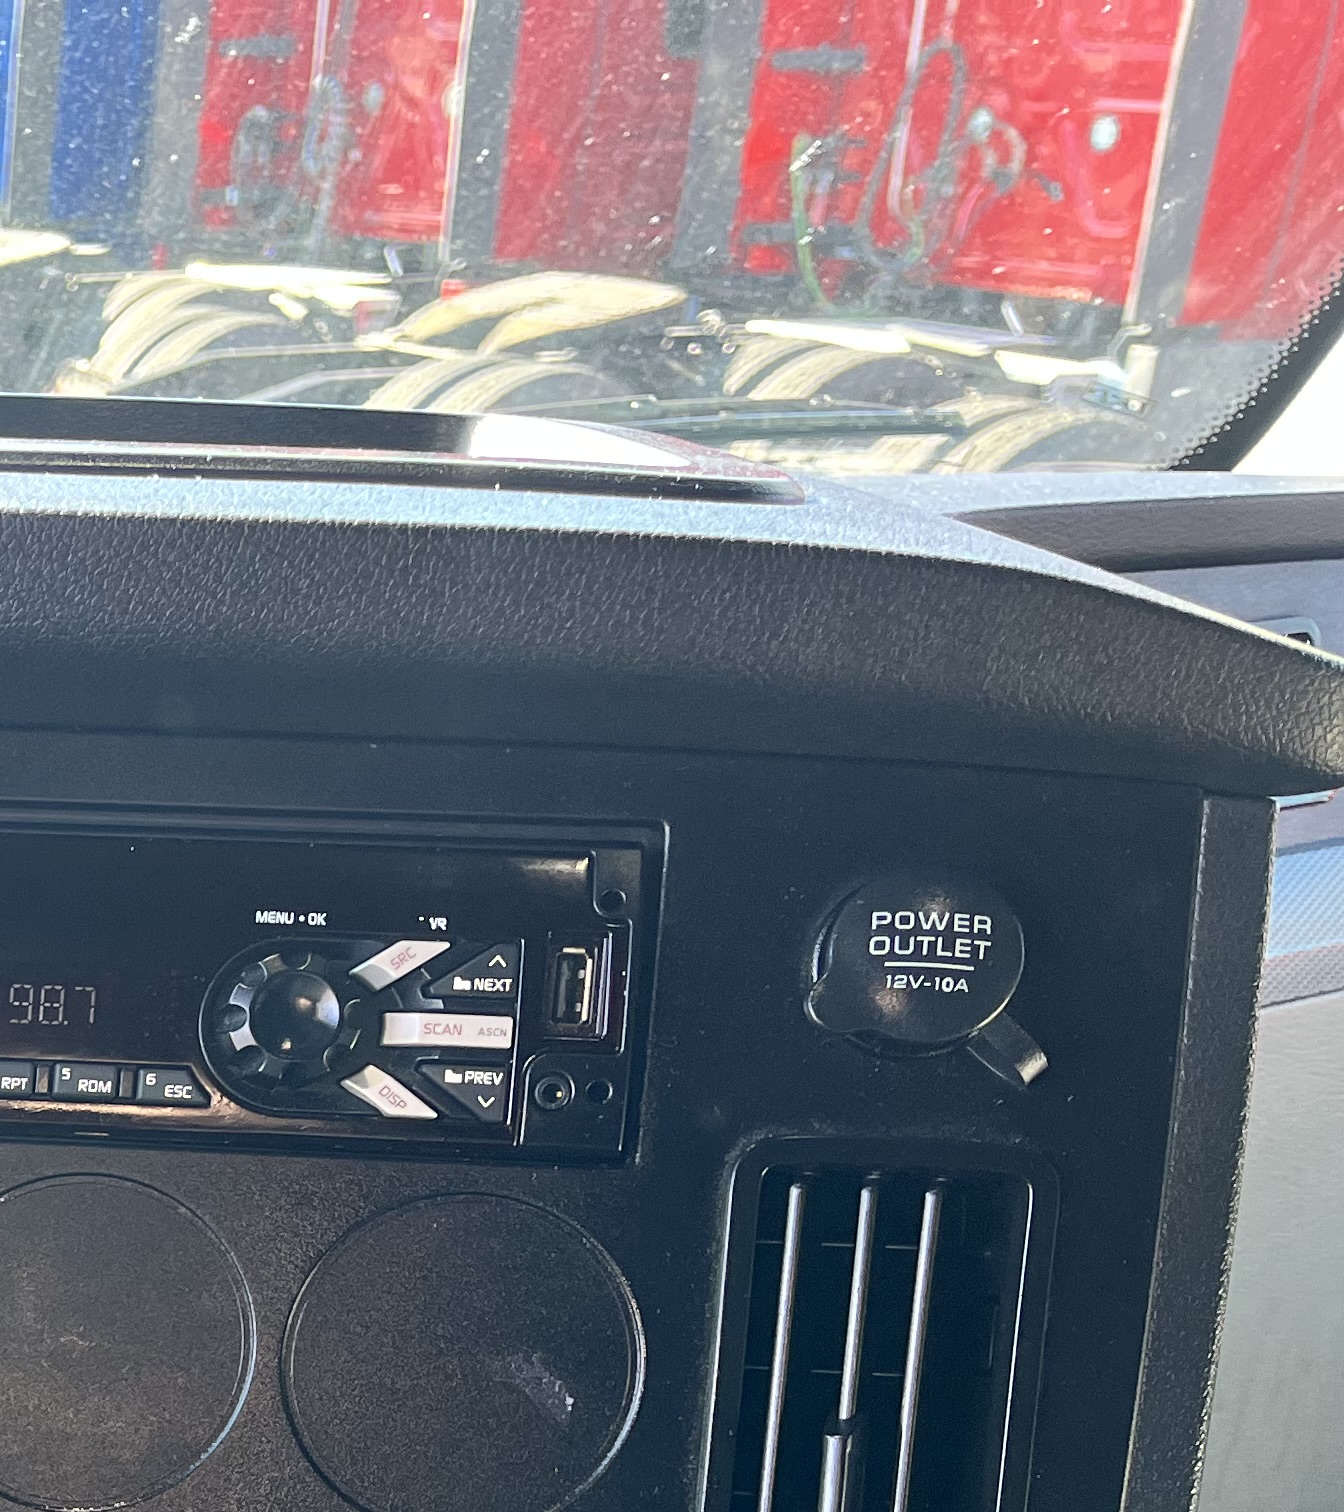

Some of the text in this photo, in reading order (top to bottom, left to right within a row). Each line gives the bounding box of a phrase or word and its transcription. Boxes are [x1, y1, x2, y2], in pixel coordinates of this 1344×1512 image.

[255, 911, 327, 926] MENU OK
[429, 917, 448, 931] VR
[870, 911, 993, 935] POWER
[868, 935, 993, 960] OUTLET
[390, 946, 418, 971] SRC
[473, 977, 513, 993] NEXT
[885, 974, 969, 993] 12V-10A
[423, 1021, 464, 1038] SCAN
[477, 1025, 508, 1039] ASCN
[60, 1066, 72, 1081] 5
[145, 1072, 157, 1086] 6
[464, 1069, 504, 1086] PREV
[0, 1076, 29, 1092] RPT
[78, 1078, 113, 1094] RDM
[164, 1084, 193, 1100] ESC
[377, 1084, 408, 1110] DISP
